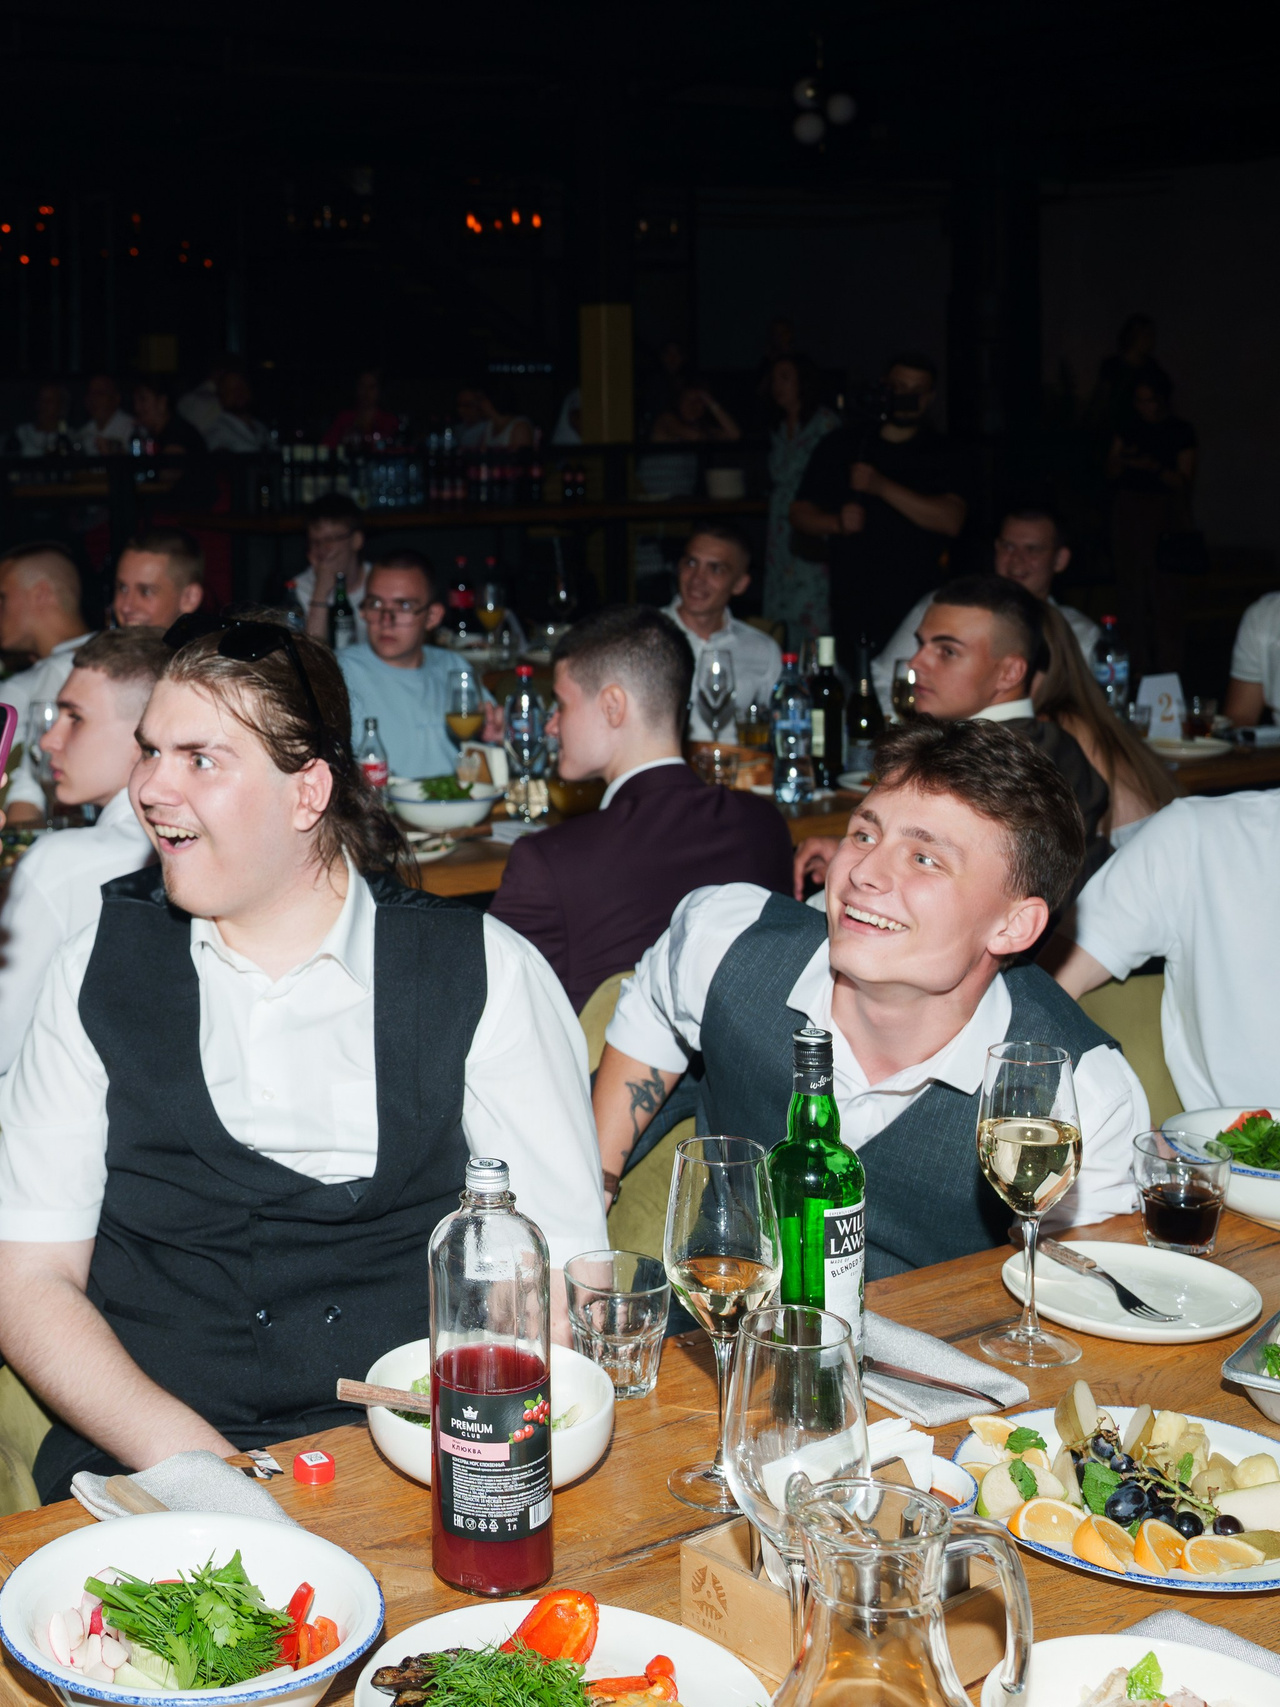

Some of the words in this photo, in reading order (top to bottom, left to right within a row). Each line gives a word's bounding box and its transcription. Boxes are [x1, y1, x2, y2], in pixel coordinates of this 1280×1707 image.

[1157, 692, 1175, 723] 2
[830, 1259, 858, 1277] BLENDED
[451, 1417, 493, 1434] PREMIUM
[461, 1431, 481, 1440] CLUB
[451, 1444, 482, 1455] КЛЮКВА
